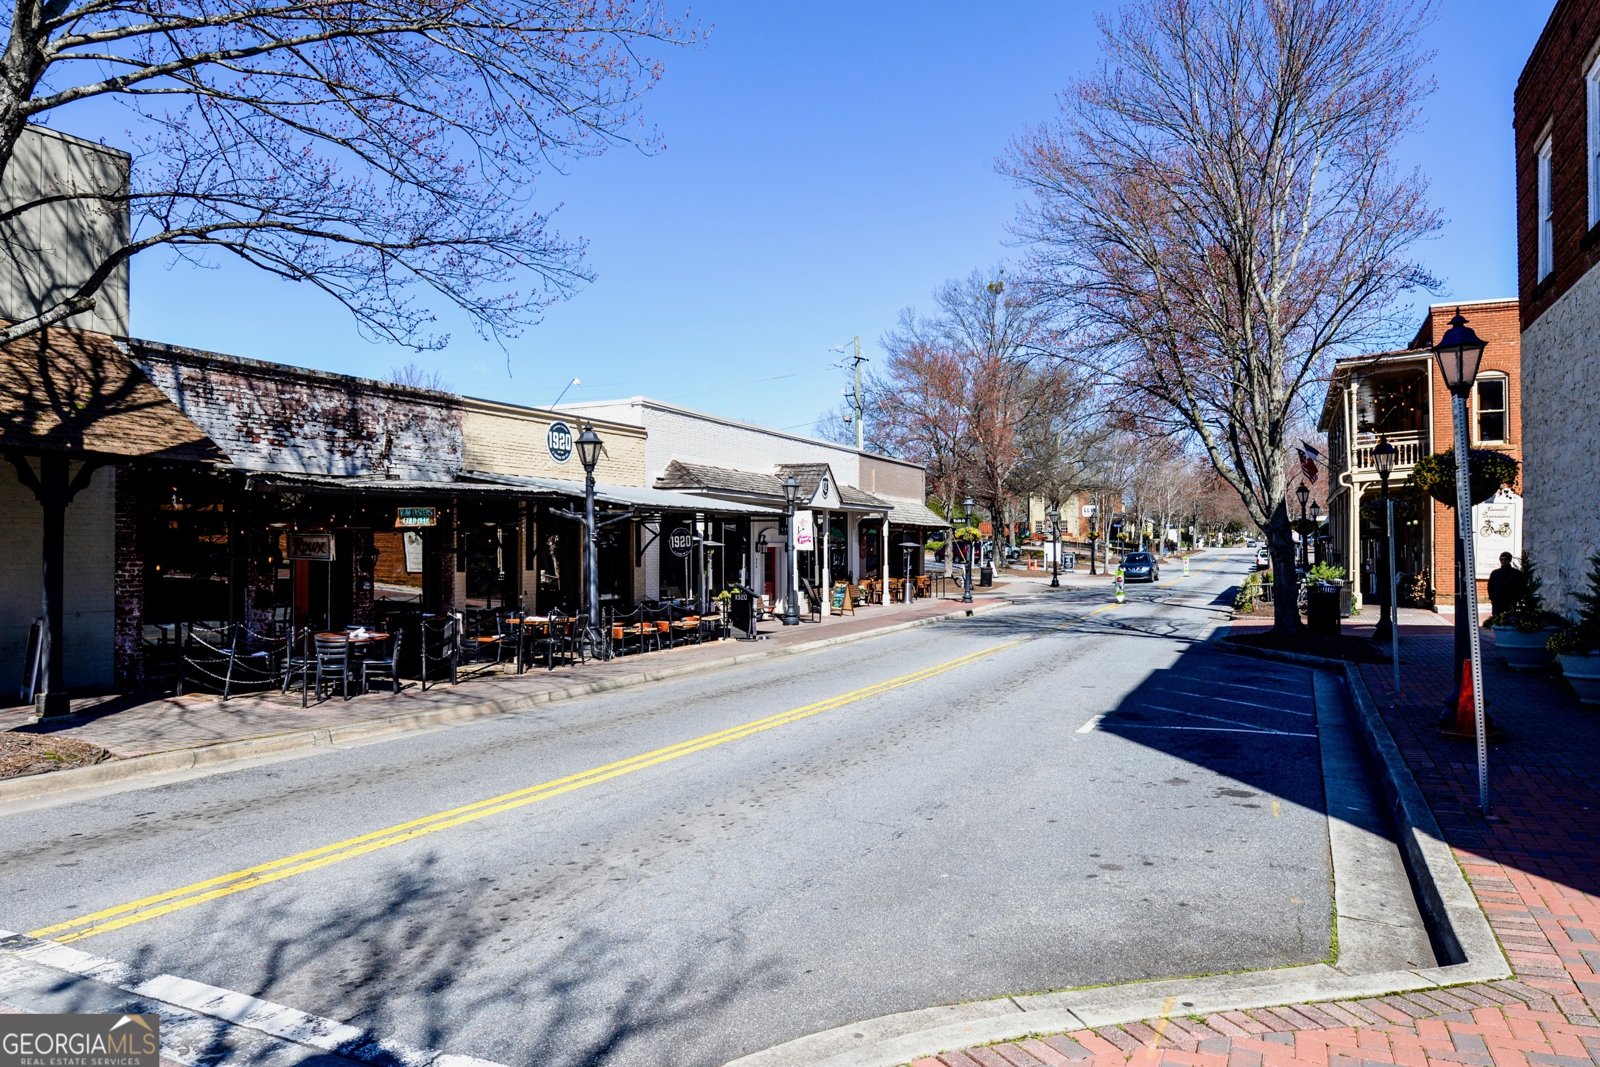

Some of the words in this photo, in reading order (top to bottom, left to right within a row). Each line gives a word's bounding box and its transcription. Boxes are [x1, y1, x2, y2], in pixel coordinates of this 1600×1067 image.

[548, 430, 571, 451] 1920
[292, 537, 326, 555] Roux
[671, 535, 691, 548] 1920
